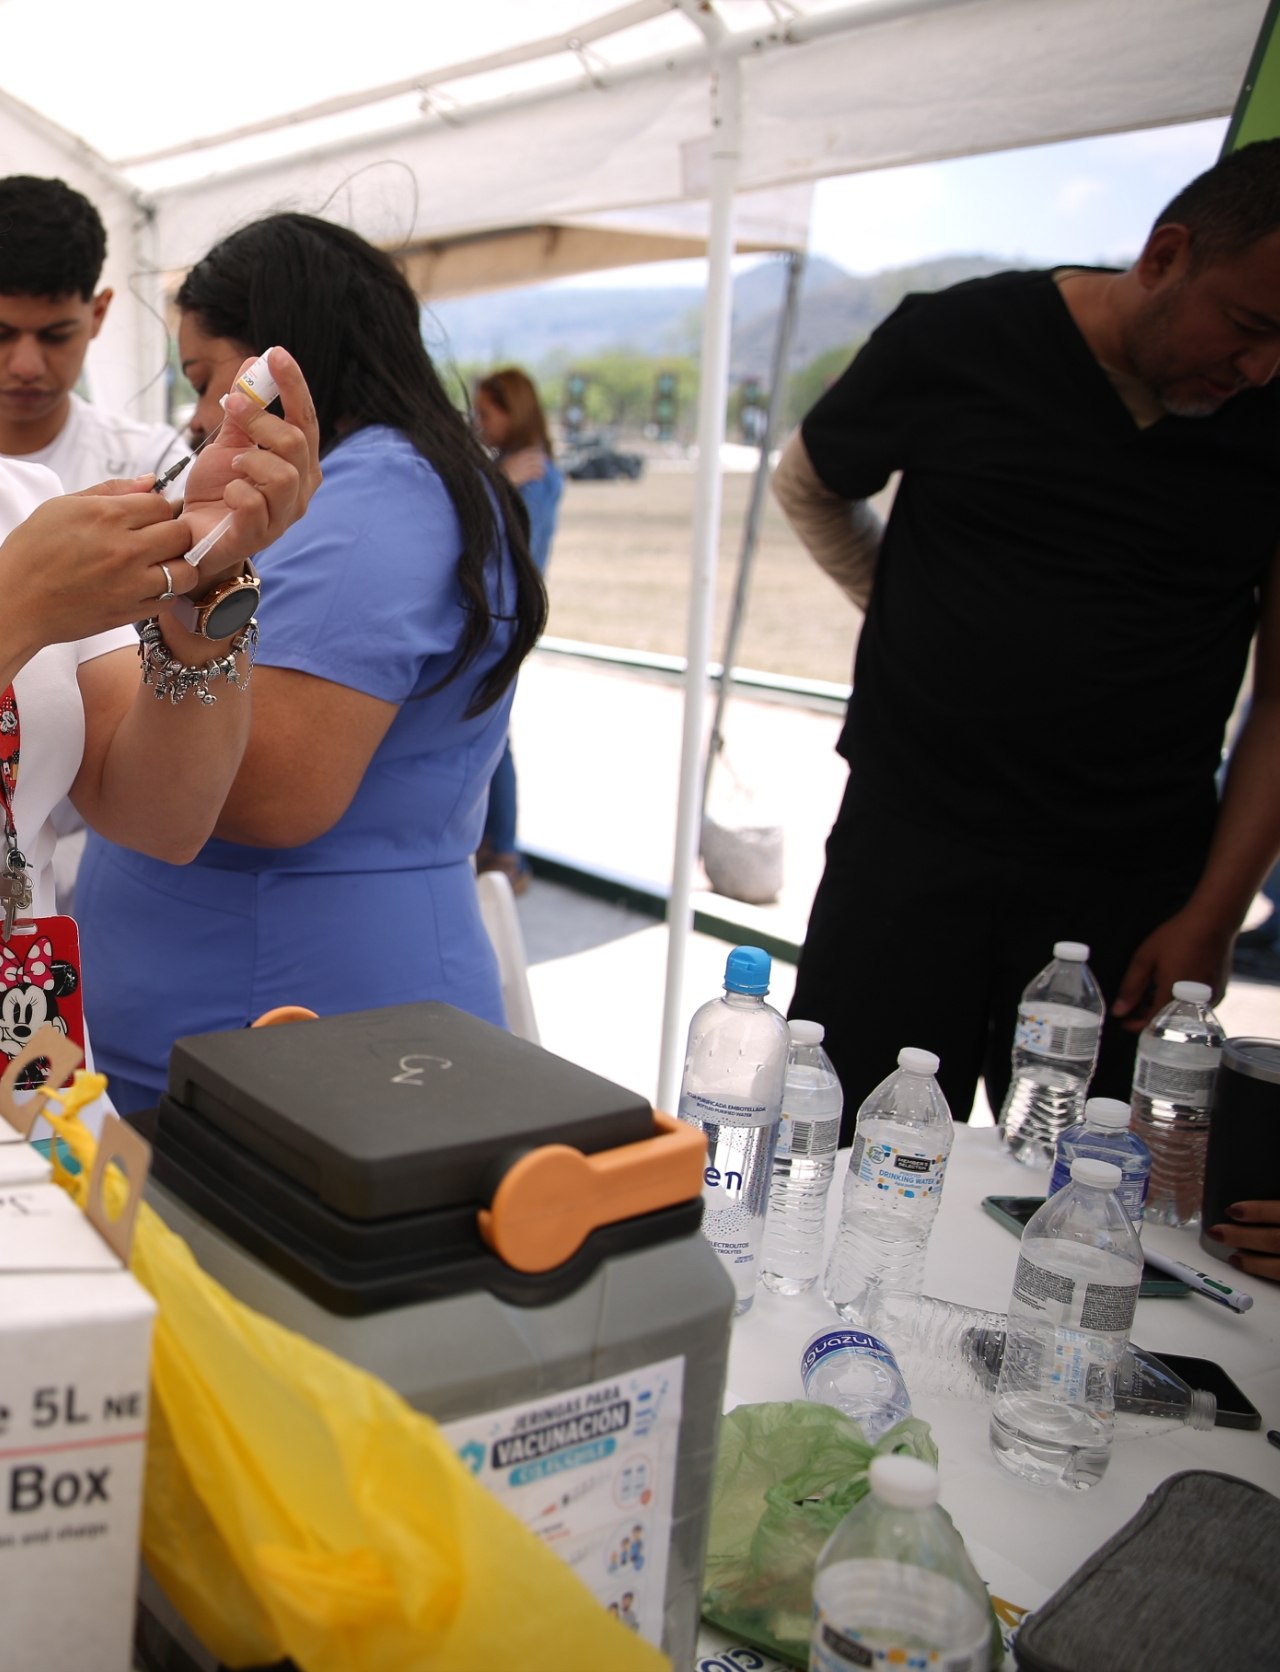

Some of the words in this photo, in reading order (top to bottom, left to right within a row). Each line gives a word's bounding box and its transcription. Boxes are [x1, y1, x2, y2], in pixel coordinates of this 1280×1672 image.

[728, 1104, 766, 1113] EMBOTELLADA
[879, 1169, 915, 1184] DRINKING
[710, 1241, 749, 1249] LECTROLITOS
[32, 1385, 89, 1429] 5L
[9, 1466, 111, 1513] Box
